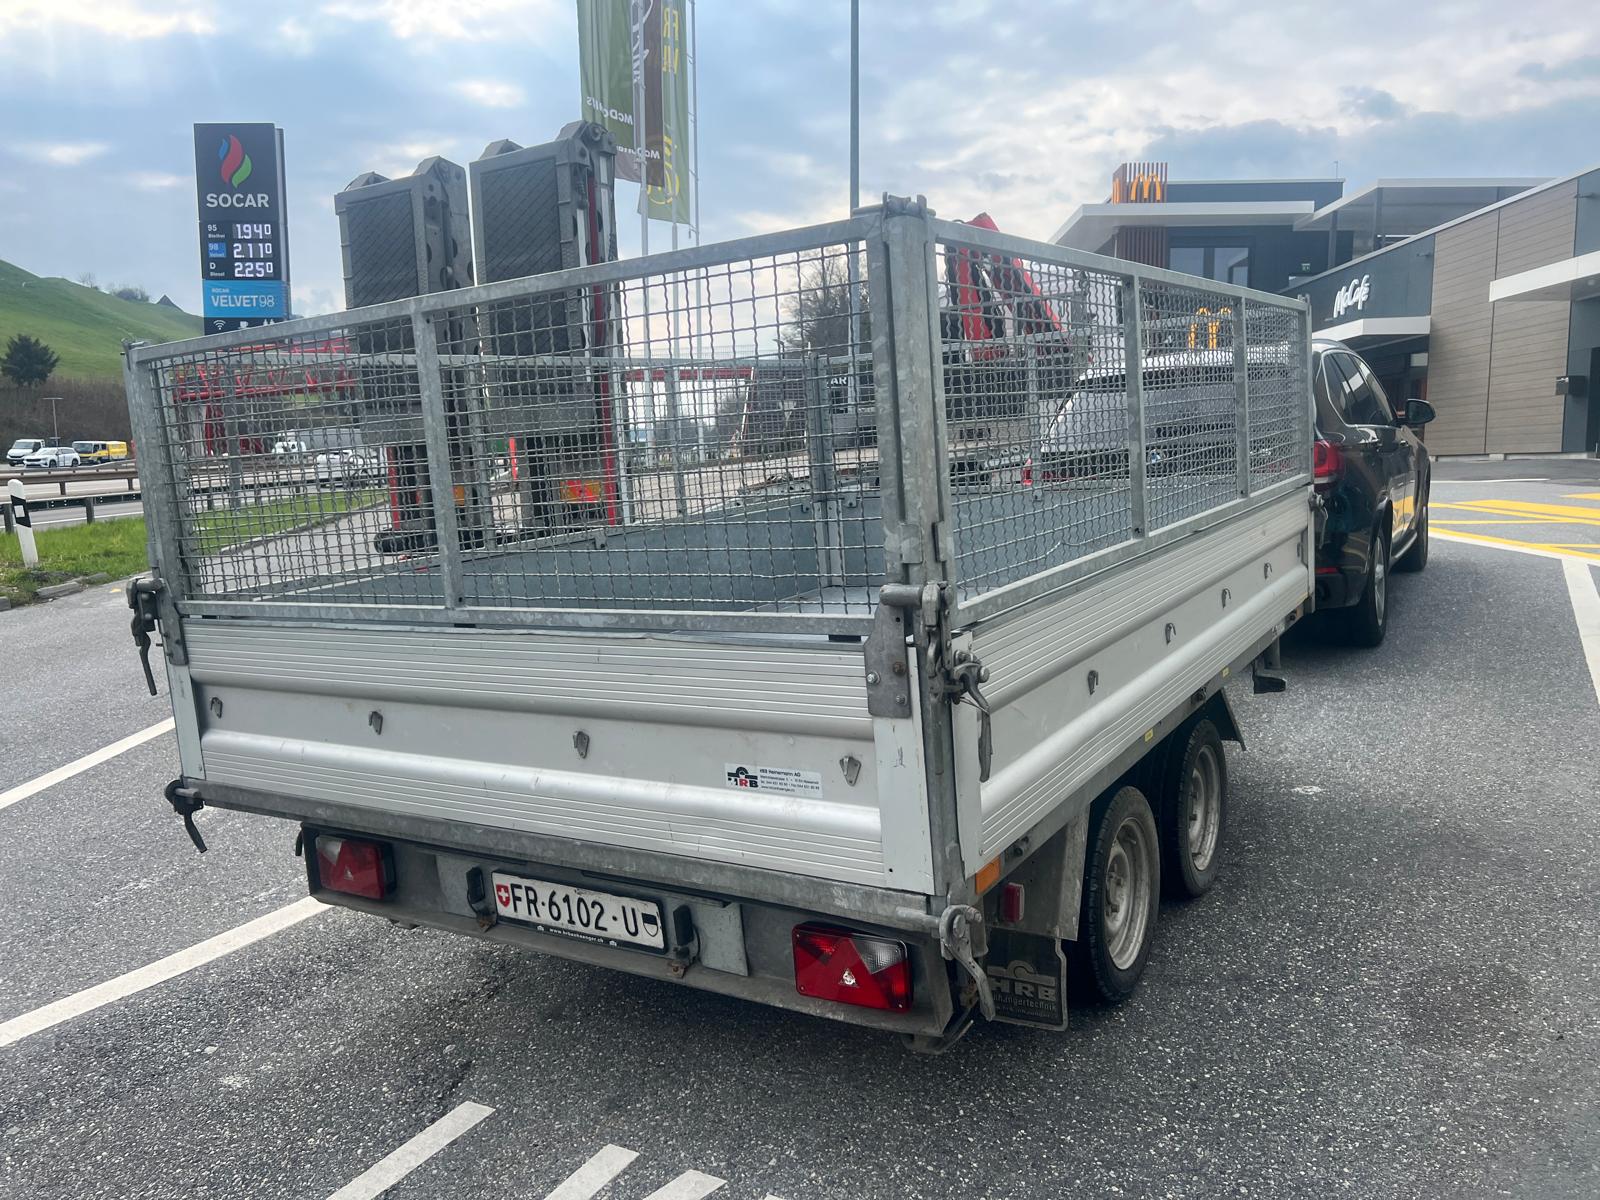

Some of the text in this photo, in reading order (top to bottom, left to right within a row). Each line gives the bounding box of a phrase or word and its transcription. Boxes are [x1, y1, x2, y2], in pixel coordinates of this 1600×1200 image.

[206, 193, 269, 208] SOCAR
[207, 224, 217, 232] 95
[208, 243, 219, 251] 98
